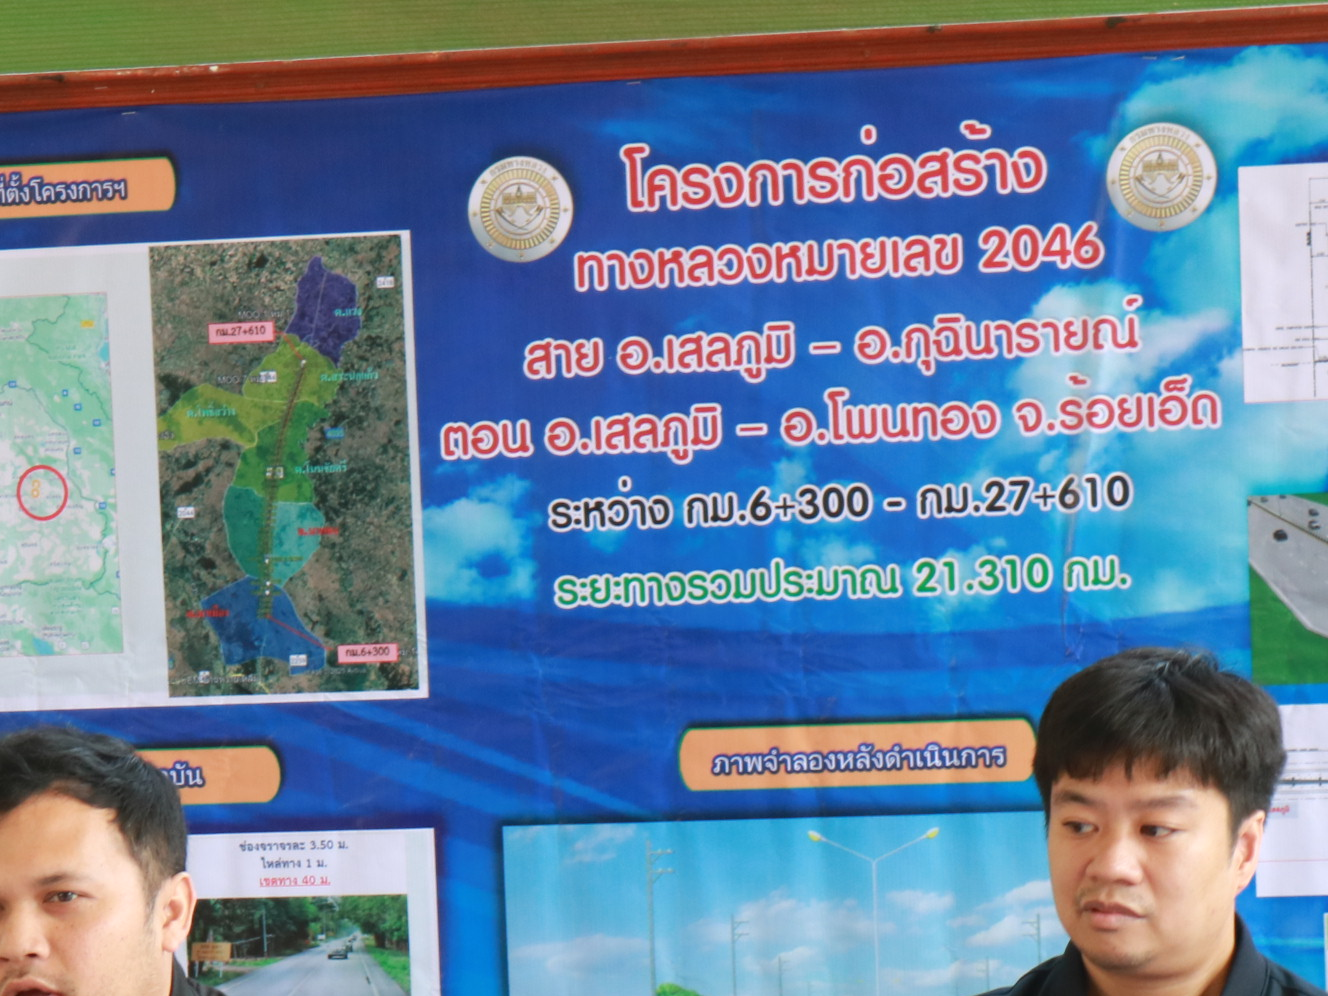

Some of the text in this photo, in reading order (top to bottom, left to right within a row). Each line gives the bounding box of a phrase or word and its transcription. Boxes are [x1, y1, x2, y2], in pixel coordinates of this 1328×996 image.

[619, 120, 1047, 211] โครงการก่อสร้าง
[574, 220, 1105, 291] ทางหลวงหมายเลข 2046
[215, 325, 266, 337] กม.27+610
[524, 337, 603, 379] สาย
[617, 321, 795, 383] อ.เสลภูมิ
[855, 294, 1143, 376] อ.กุฉินารายณ์
[441, 419, 534, 460] ตอน
[544, 403, 722, 465] อ.เสลภูมิ
[781, 388, 1001, 446] อ.โพนทอง
[1013, 373, 1222, 434] จ.ร้อยเอ็ด
[548, 476, 673, 532] ระหว่าง
[684, 482, 872, 528] กม.6+300
[916, 474, 1134, 519] กม.27+610
[554, 554, 1132, 608] ระยะทางรวมประมาณ 21.310 กม.
[712, 743, 1006, 775] ภาพจำลองหลังดำเนินการ
[306, 859, 312, 869] 1
[310, 840, 334, 850] 3.50
[302, 875, 316, 886] 40
